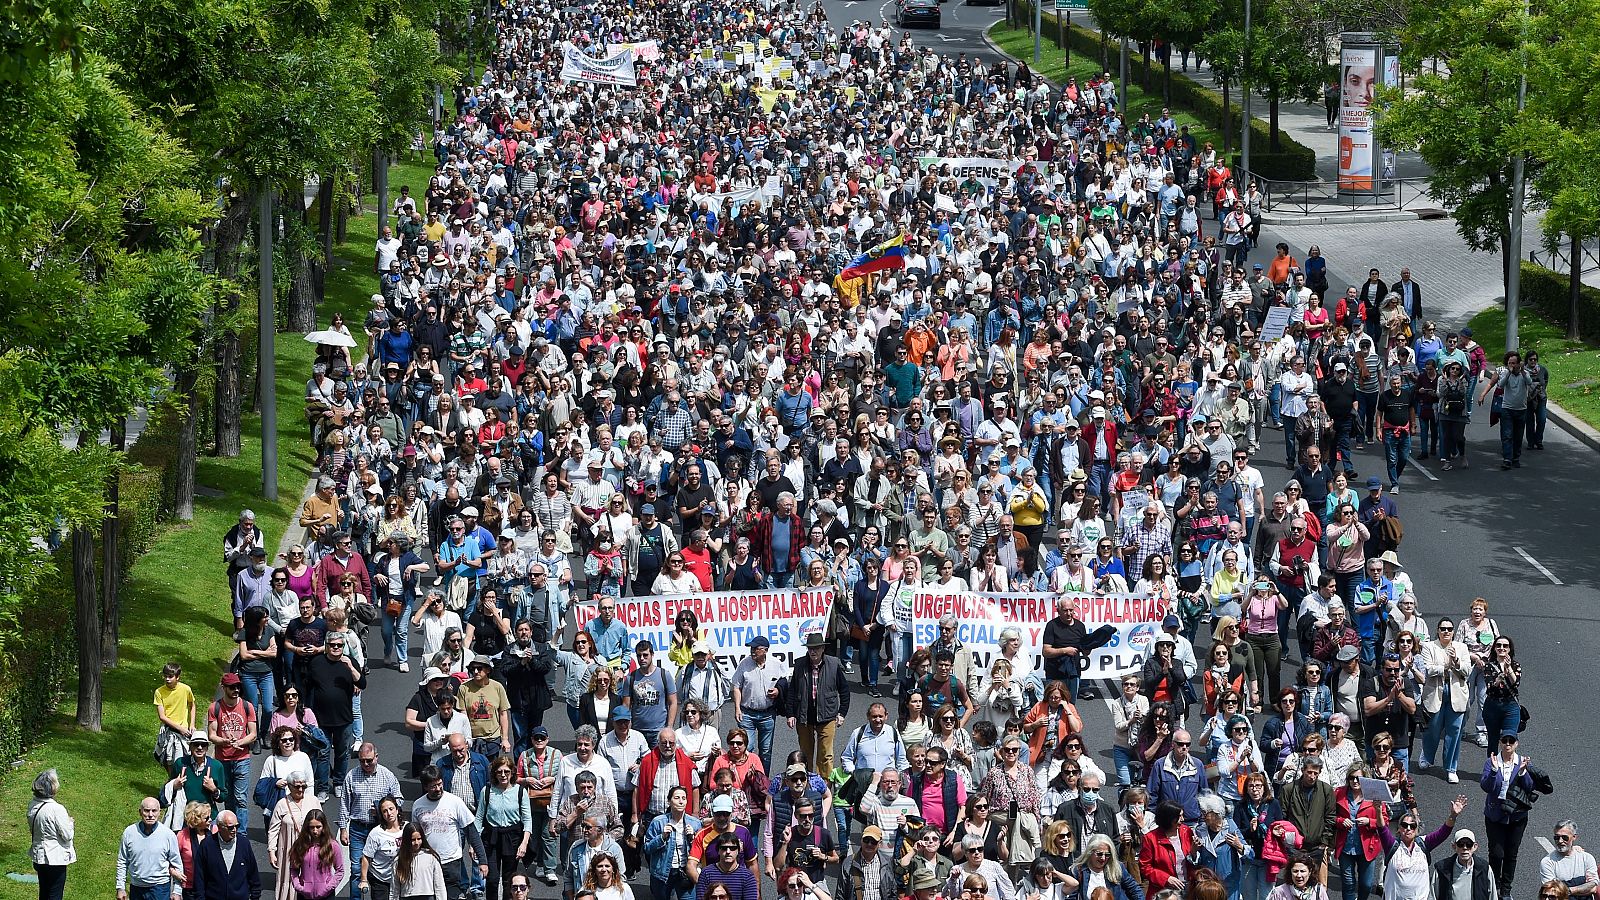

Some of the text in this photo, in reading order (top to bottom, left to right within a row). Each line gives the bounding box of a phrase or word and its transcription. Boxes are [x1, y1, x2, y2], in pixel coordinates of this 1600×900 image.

[718, 591, 833, 622] HOSPITALARIAS
[1000, 598, 1047, 622] EXTRA
[1052, 597, 1165, 623] HSPITALARIAS
[1029, 627, 1041, 646] Y
